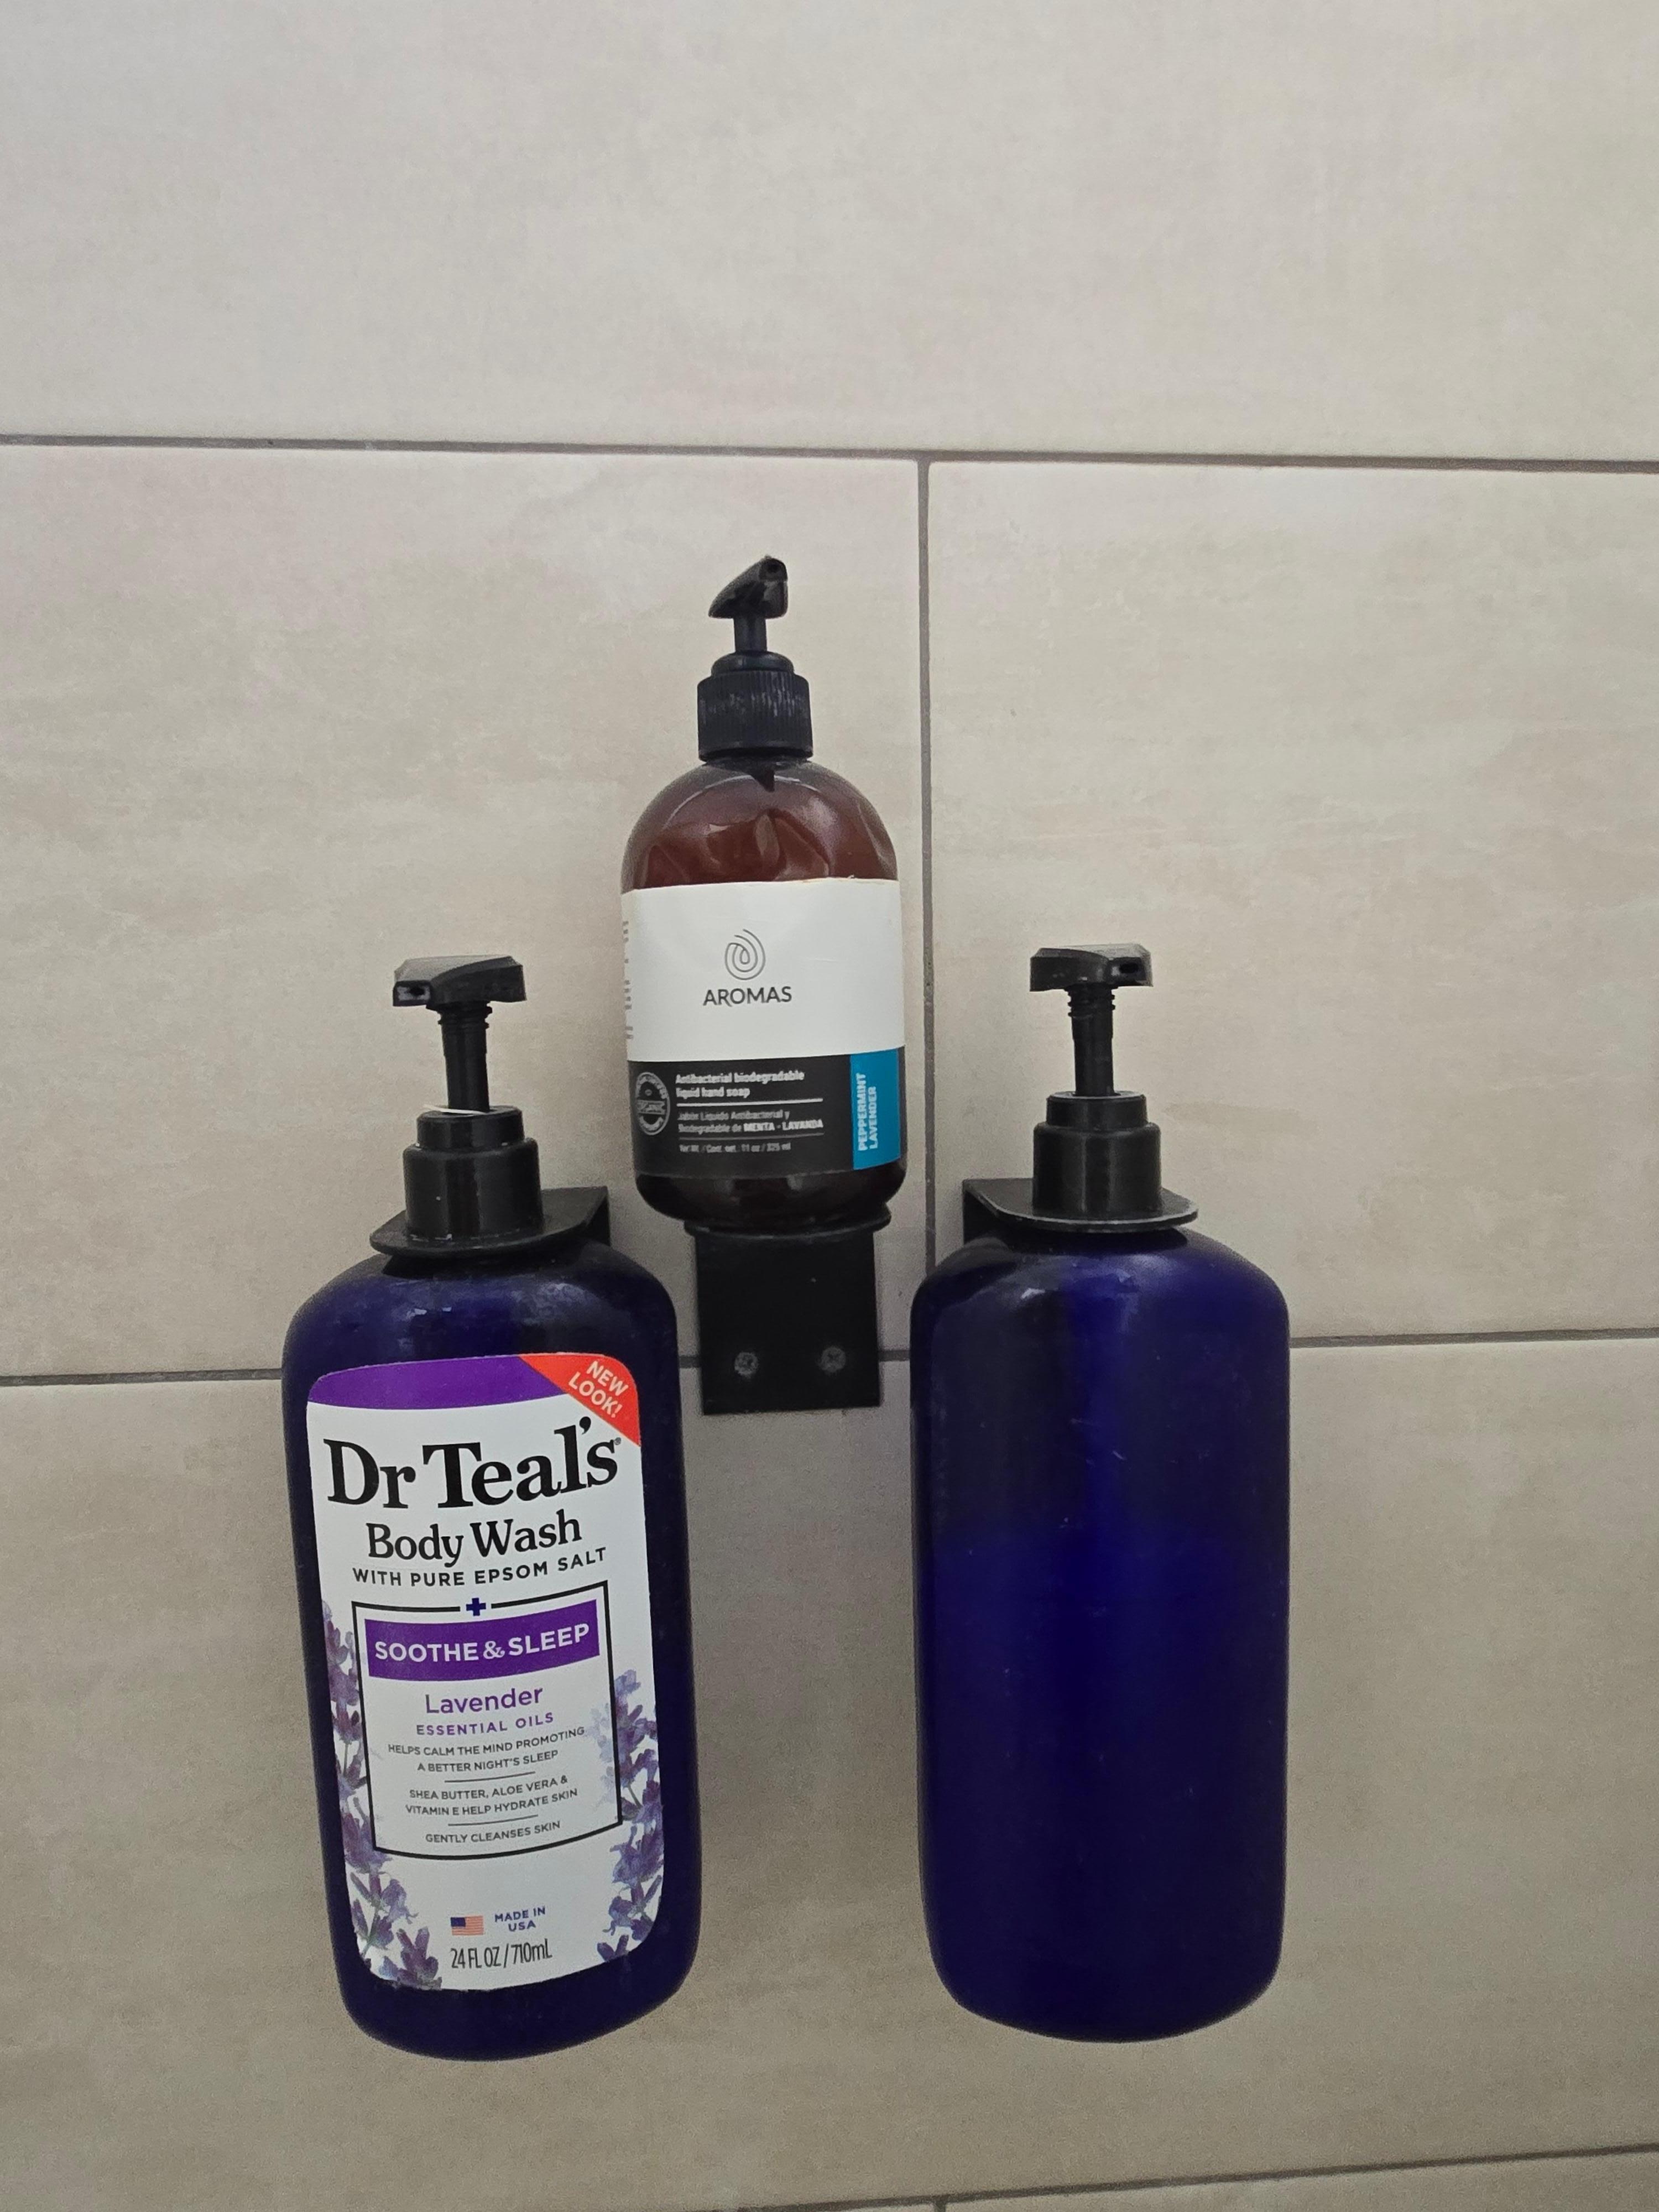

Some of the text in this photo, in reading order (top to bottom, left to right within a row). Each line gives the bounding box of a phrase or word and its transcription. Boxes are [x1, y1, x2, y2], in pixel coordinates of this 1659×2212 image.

[703, 986, 792, 1006] AROMAS
[856, 1072, 868, 1151] PEPPERMINT
[868, 1086, 878, 1149] LAVENDER
[586, 1360, 629, 1396] NEW
[568, 1371, 623, 1418] LOOK!
[323, 1438, 416, 1509] Dr
[366, 1509, 582, 1567] Body Wash
[352, 1547, 607, 1587] WITH PURE EPSOM SALT
[374, 1623, 590, 1662] SOOTHE & SLEEP
[425, 1687, 543, 1714] Lavender
[416, 1712, 554, 1736] ESSENTIAL OILS
[388, 1726, 585, 1756] HELPS CALM THE MIND PROMOTING
[416, 1750, 559, 1772] A BETTER NIGHT'S SLEEP
[409, 1775, 568, 1800] SHEA BUTTER, ALOE VERA &
[405, 1788, 578, 1816] VITAMIN E HELP HYDRATE SKIN
[425, 1820, 561, 1844] GENTLY CLEANSES SKIN
[494, 1906, 546, 1923] MADE IN
[508, 1919, 536, 1932] USA
[450, 1947, 466, 1969] 24
[468, 1947, 482, 1969] FL
